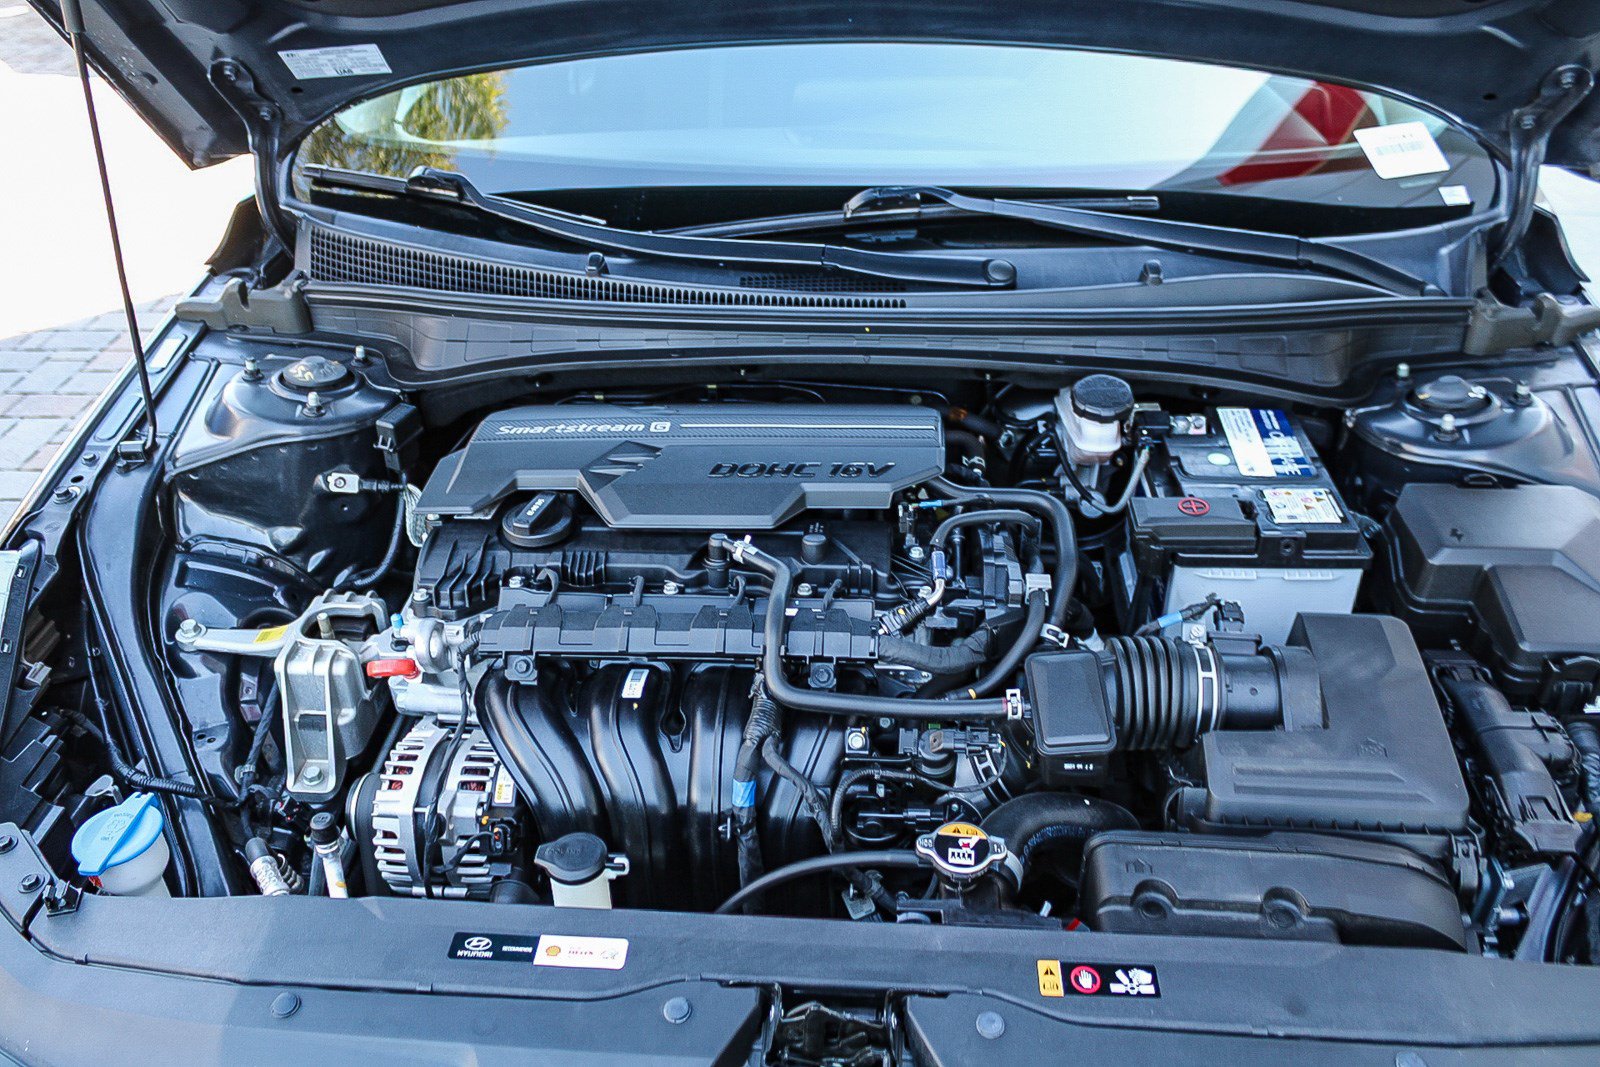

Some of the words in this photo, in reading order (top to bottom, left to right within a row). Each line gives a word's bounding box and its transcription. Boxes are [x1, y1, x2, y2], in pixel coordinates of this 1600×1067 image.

[495, 422, 645, 435] Smartstream
[708, 461, 822, 478] DOHC
[828, 461, 897, 478] 16V
[456, 949, 494, 959] HYUNDAI
